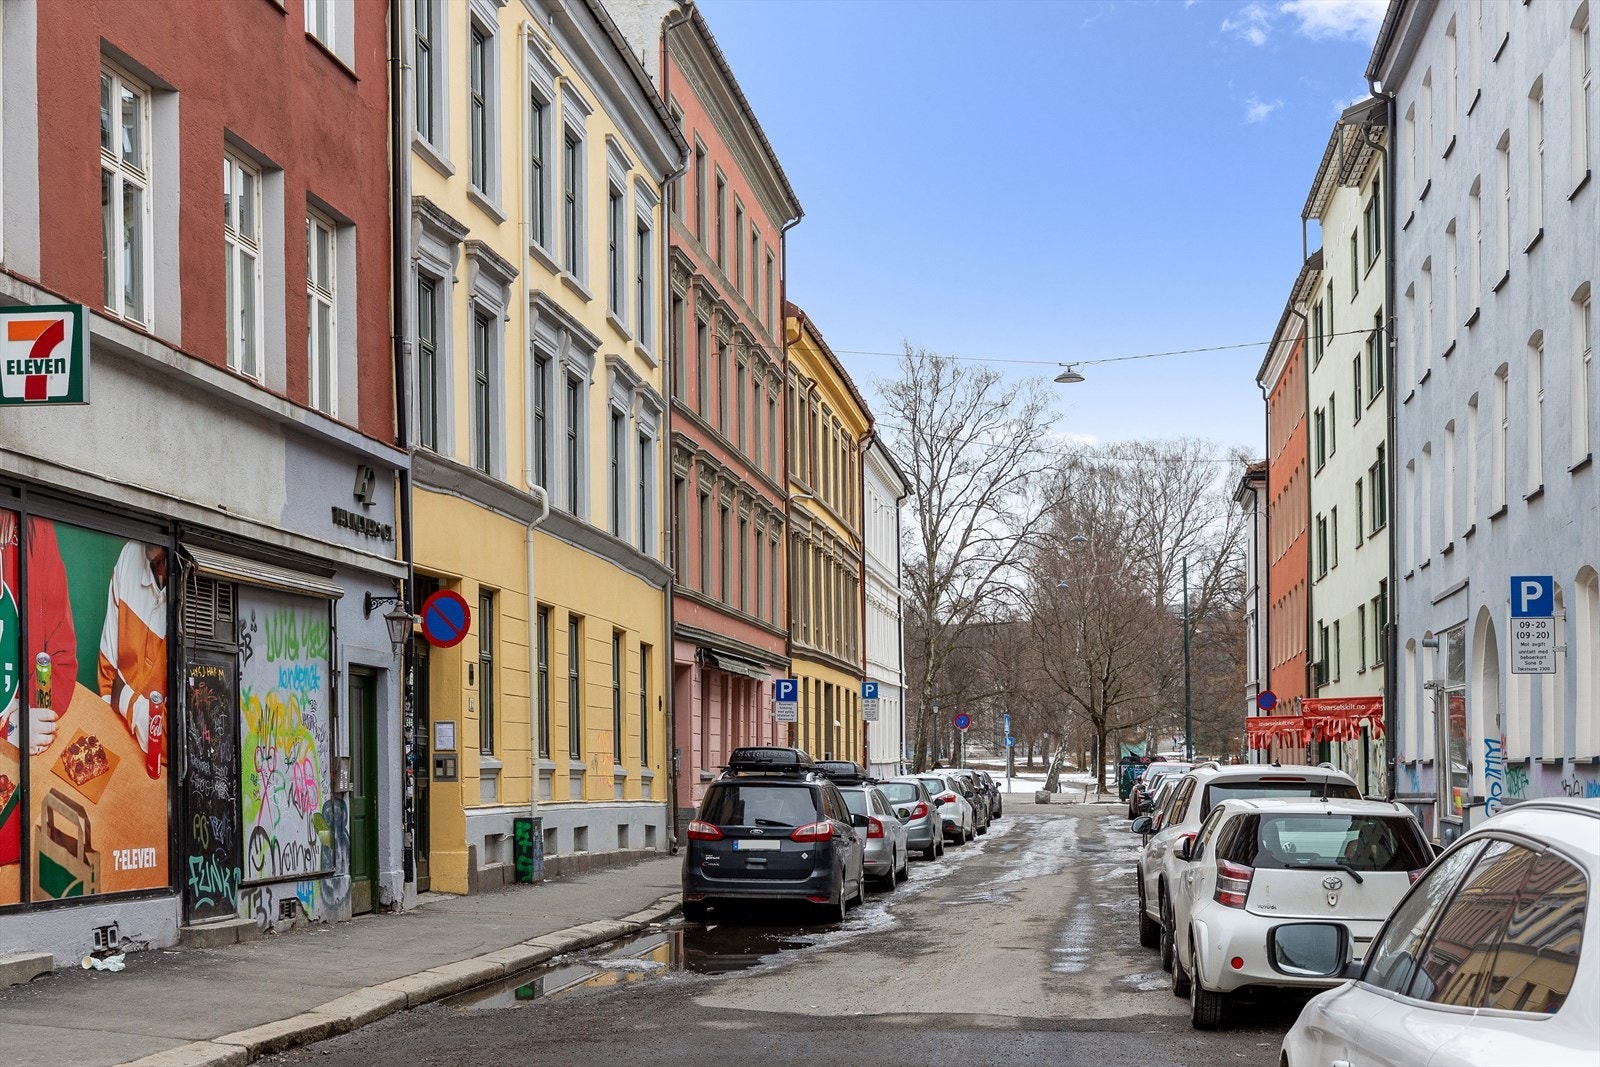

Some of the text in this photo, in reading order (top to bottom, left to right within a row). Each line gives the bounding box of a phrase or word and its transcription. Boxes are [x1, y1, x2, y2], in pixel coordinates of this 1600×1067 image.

[8, 319, 65, 401] 7
[1521, 581, 1543, 612] P
[780, 681, 793, 699] P
[865, 684, 875, 697] P
